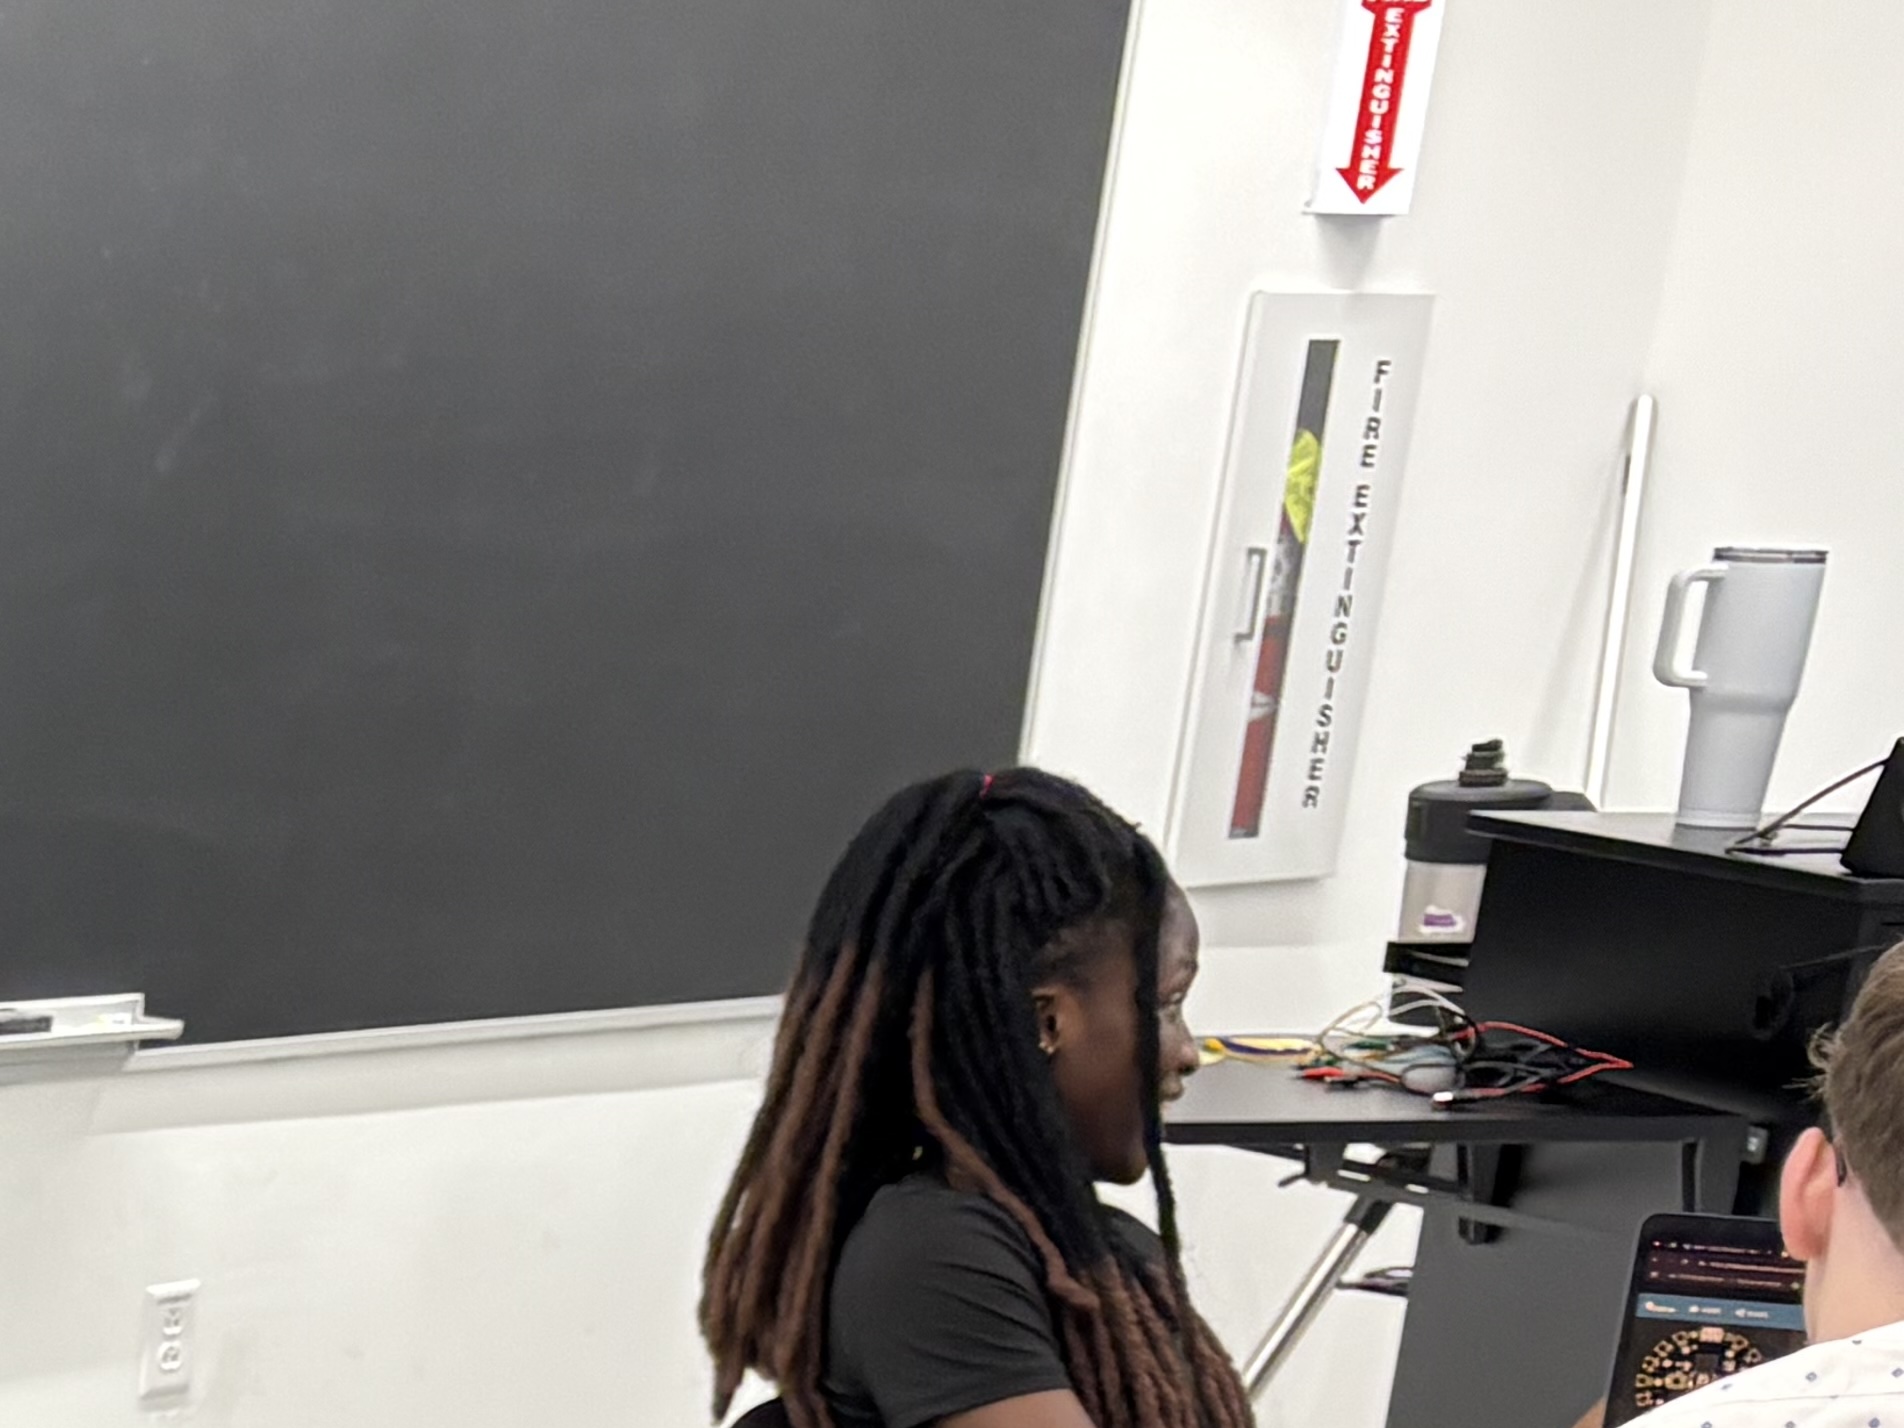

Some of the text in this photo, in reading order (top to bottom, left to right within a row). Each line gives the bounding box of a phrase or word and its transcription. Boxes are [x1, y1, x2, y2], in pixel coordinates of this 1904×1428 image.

[1356, 7, 1405, 190] EXTINGUISHER
[1302, 359, 1391, 809] FIRE EXTINGUISHER
